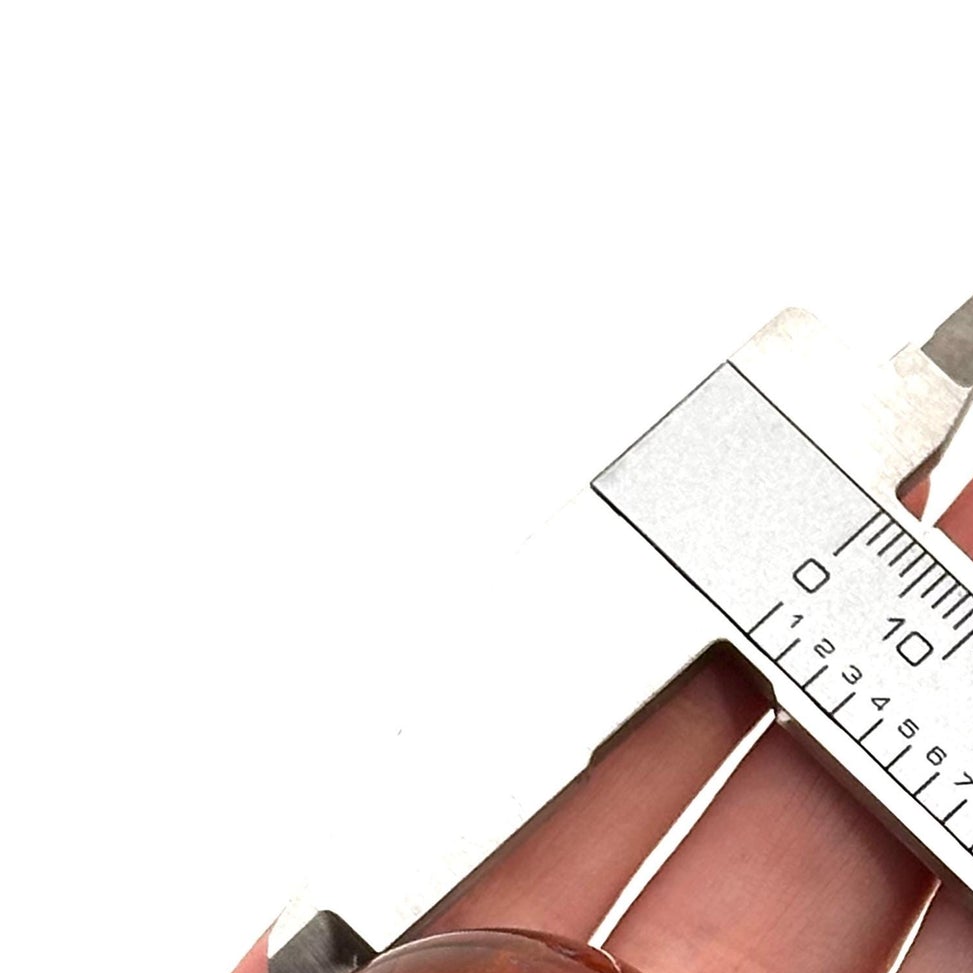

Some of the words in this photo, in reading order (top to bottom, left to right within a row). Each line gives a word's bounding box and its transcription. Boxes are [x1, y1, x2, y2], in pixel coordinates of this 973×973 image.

[793, 558, 831, 594] 0
[790, 614, 804, 628] 1
[813, 638, 836, 659] 2
[882, 617, 934, 667] 10
[841, 664, 863, 685] 3
[870, 696, 891, 711] 4
[897, 718, 920, 739] 5
[926, 746, 948, 766] 6
